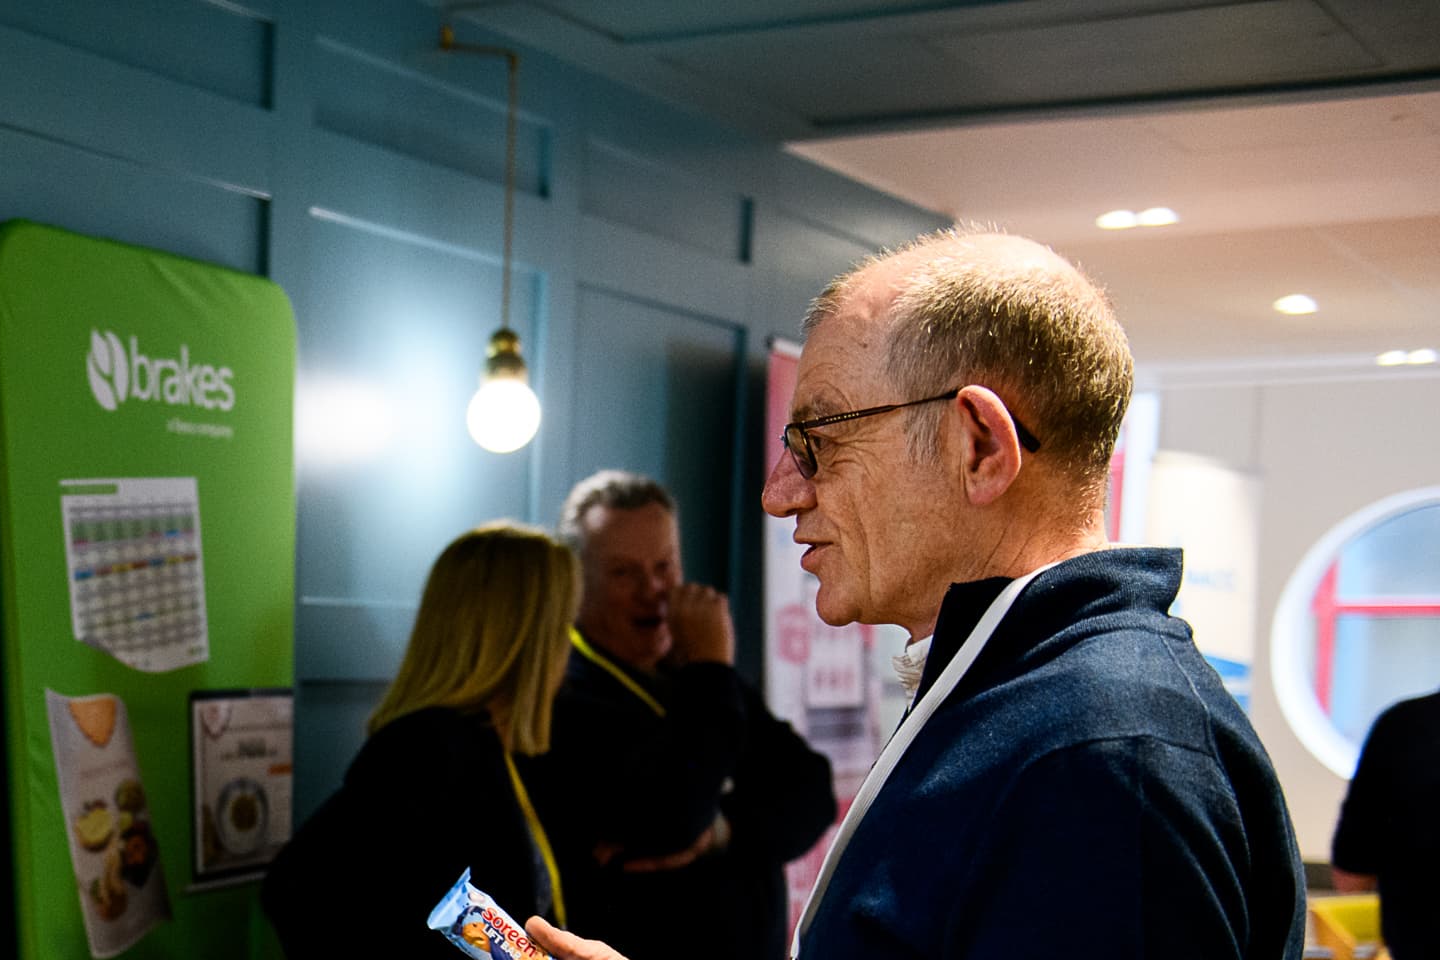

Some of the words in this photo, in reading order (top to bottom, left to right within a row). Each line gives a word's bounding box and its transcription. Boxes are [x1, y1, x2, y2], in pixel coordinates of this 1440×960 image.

[130, 335, 235, 411] brakes
[482, 907, 538, 958] Soreen
[482, 924, 505, 944] LIFT
[500, 941, 522, 960] BAR
